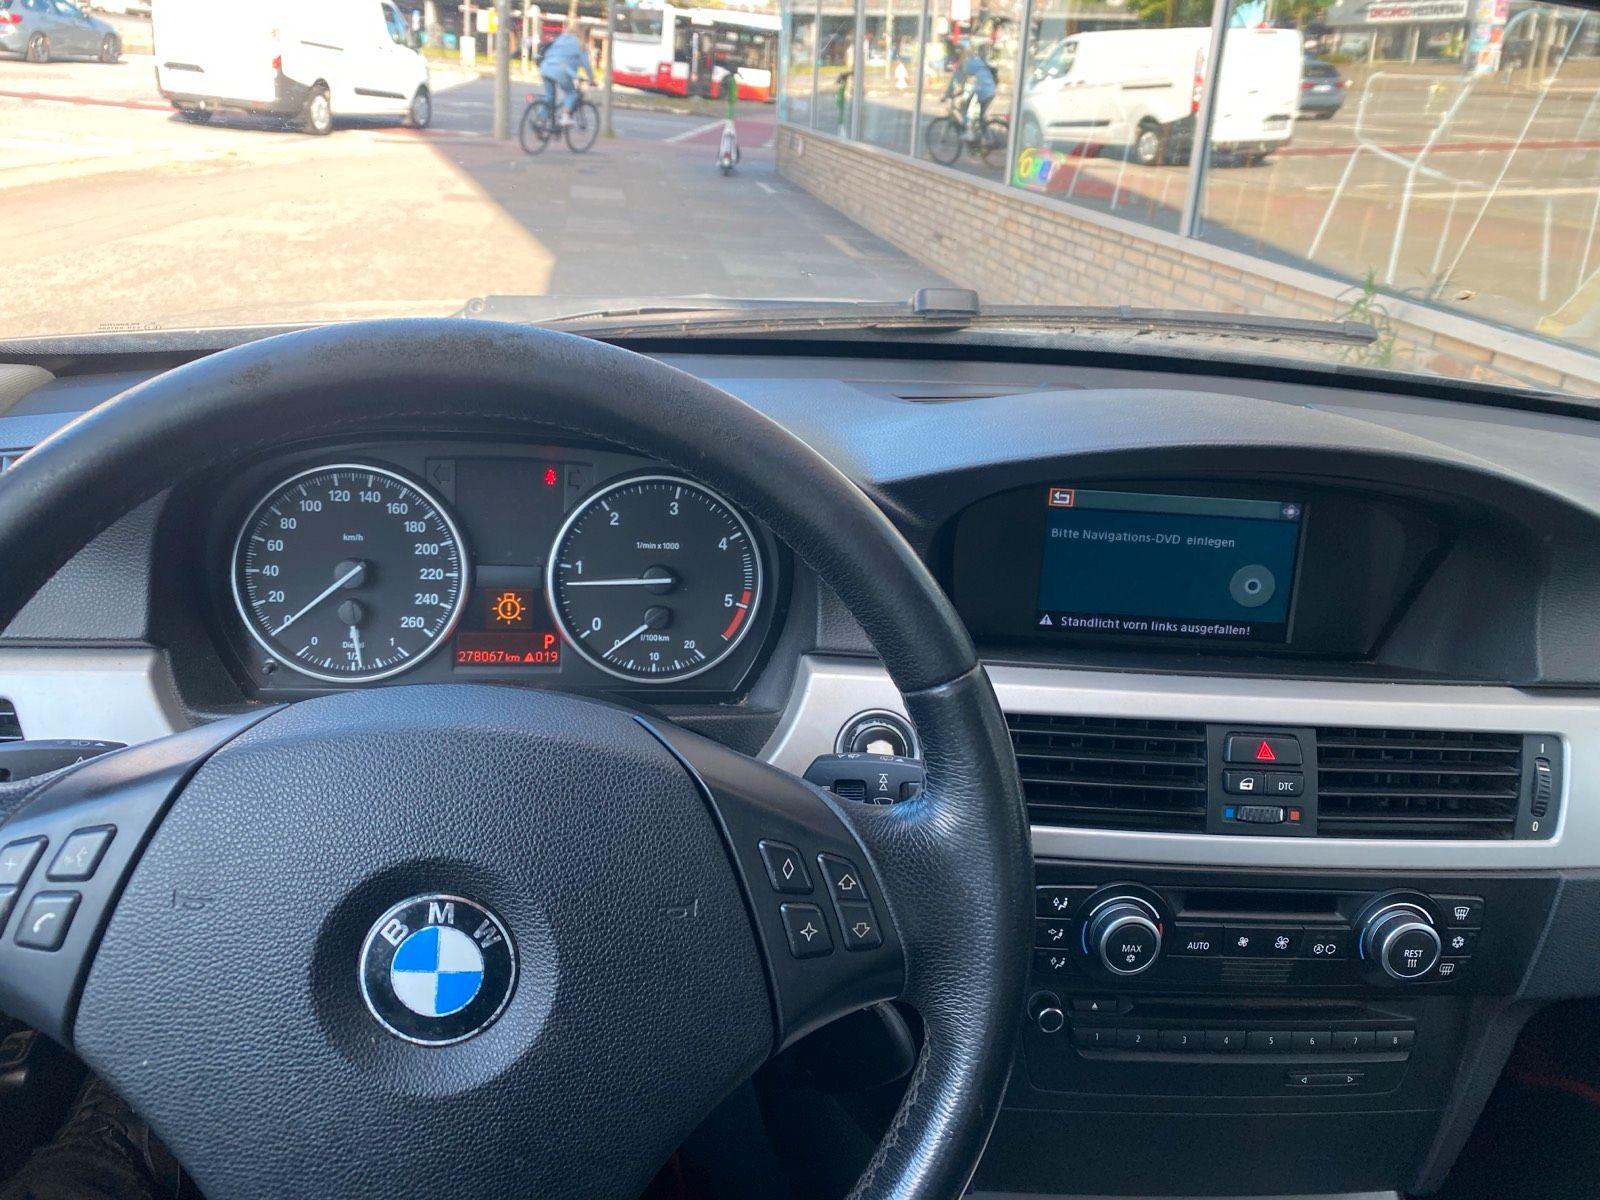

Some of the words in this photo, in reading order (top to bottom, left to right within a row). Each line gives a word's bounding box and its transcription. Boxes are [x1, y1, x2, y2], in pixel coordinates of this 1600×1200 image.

[328, 490, 350, 502] 120
[359, 491, 381, 502] 140
[300, 500, 322, 512] 100
[386, 503, 408, 514] 160
[670, 502, 679, 516] 3
[280, 518, 296, 530] 80
[610, 512, 619, 526] 2
[404, 522, 426, 533] 180
[343, 533, 364, 542] km/h
[1051, 528, 1080, 540] Bitte
[1082, 529, 1181, 544] Navigations-DVD
[1186, 536, 1235, 548] einlegen
[267, 540, 284, 551] 60
[414, 544, 438, 555] 200
[636, 542, 656, 550] 1/min
[718, 538, 728, 550] 4
[262, 565, 279, 577] 40
[575, 560, 582, 574] 1
[420, 569, 444, 580] 220
[268, 591, 284, 602] 20
[414, 594, 439, 605] 240
[724, 594, 733, 608] 5
[401, 617, 424, 628] 260
[592, 617, 602, 631] 0
[1061, 616, 1120, 629] Standlicht
[1123, 620, 1148, 630] vorn
[1151, 621, 1178, 632] links
[1181, 623, 1250, 636] ausgefallen!
[311, 636, 318, 645] 0
[390, 638, 394, 646] 1
[544, 634, 555, 649] P
[684, 640, 695, 649] 20
[458, 651, 504, 662] 278067
[505, 653, 520, 662] km
[536, 651, 558, 662] 019
[649, 652, 660, 660] 10
[1278, 782, 1294, 790] DTC
[1532, 821, 1539, 832] 0
[380, 902, 502, 949] BMW
[1122, 944, 1142, 953] MAX
[1187, 942, 1210, 950] AUTO
[1404, 950, 1423, 958] REST
[1135, 1034, 1141, 1043] 2
[1182, 1036, 1187, 1044] 3
[1224, 1036, 1229, 1045] 4
[1269, 1037, 1274, 1045] 5
[1310, 1037, 1315, 1045] 6
[1354, 1037, 1358, 1045] 7
[1393, 1037, 1398, 1045] 8
